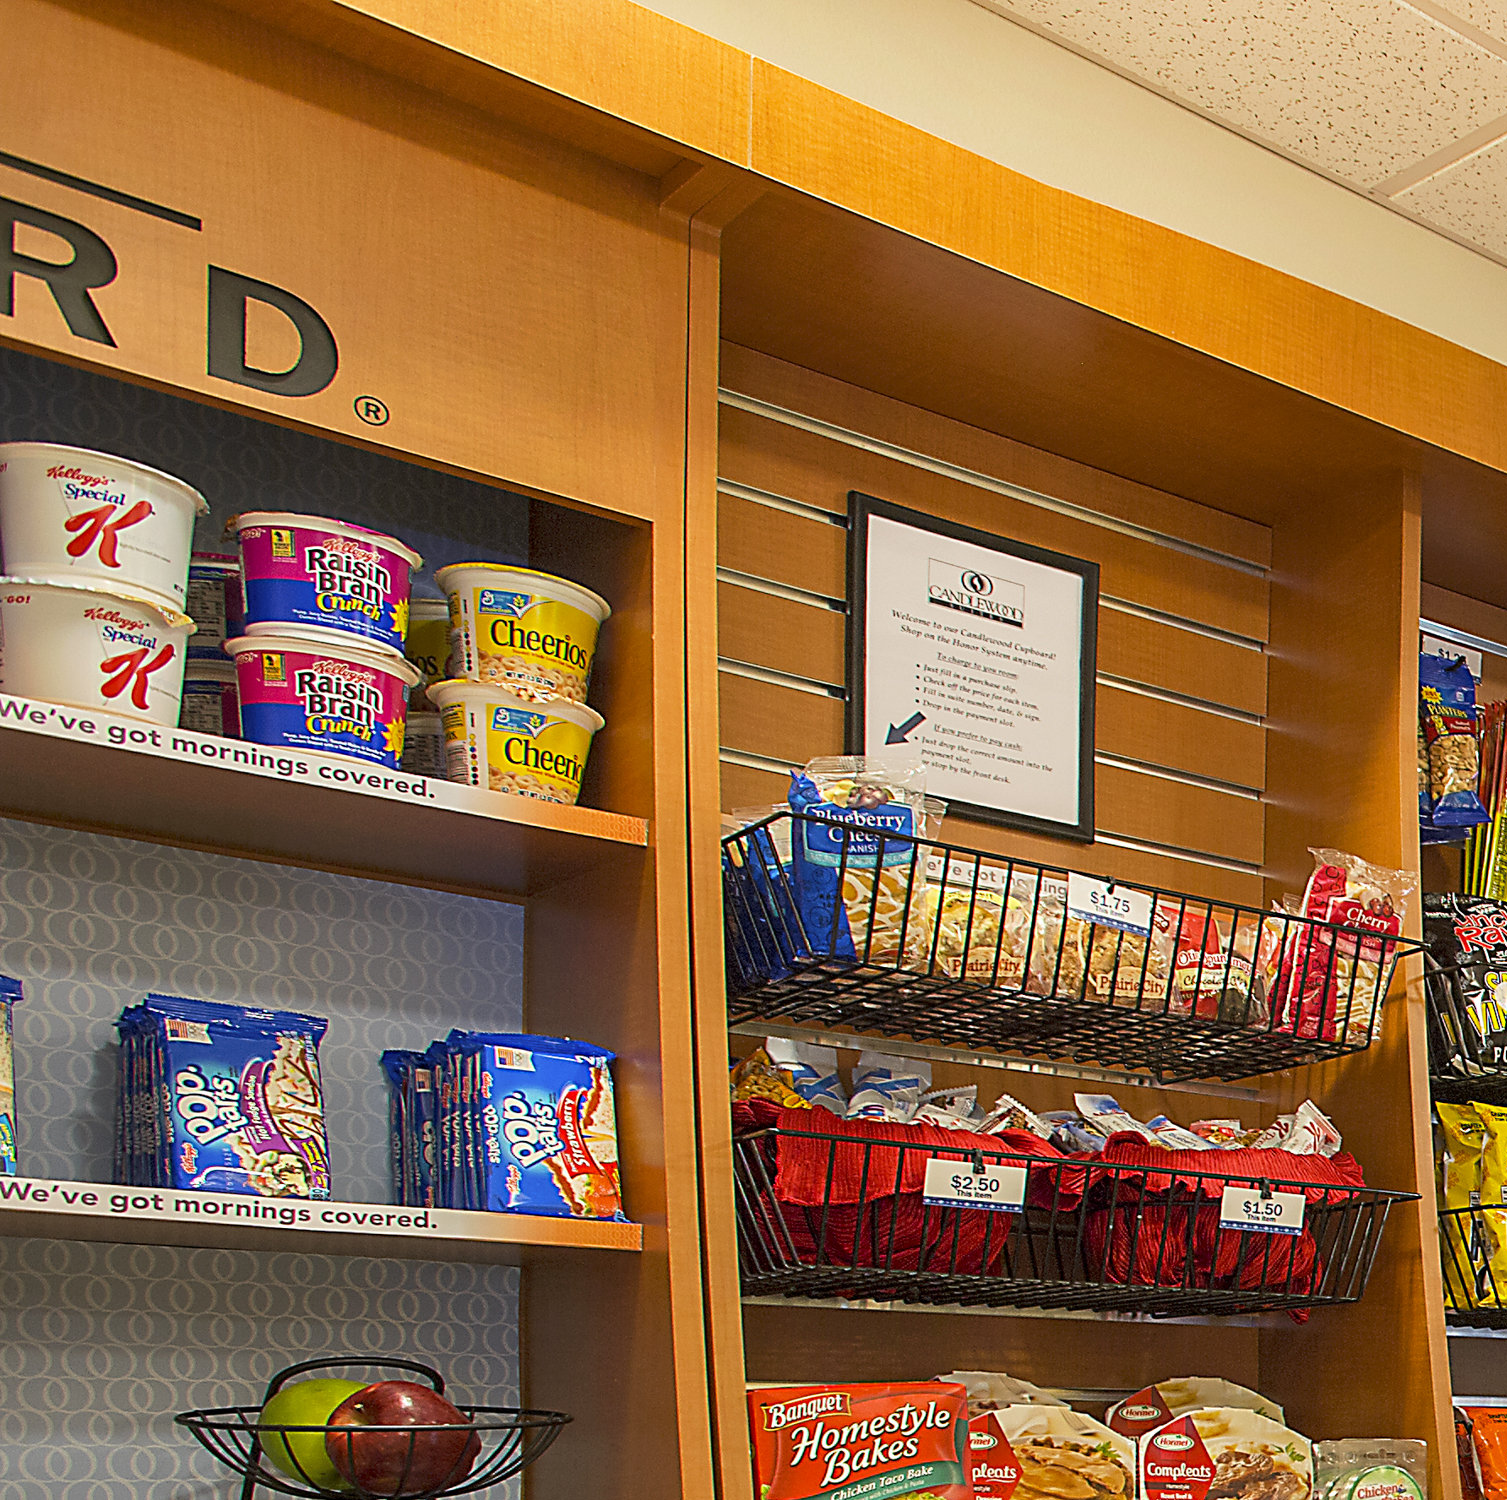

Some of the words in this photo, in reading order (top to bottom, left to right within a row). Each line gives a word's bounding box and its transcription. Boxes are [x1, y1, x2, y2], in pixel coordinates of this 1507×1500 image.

[64, 483, 126, 506] Special
[64, 501, 152, 568] K
[305, 546, 392, 594] Raisin
[315, 572, 384, 608] Bran
[316, 593, 383, 622] Crunch
[929, 585, 1024, 621] CANDLEWOOD
[103, 626, 157, 649] Special
[490, 619, 588, 669] Cheerios
[892, 609, 932, 627] Welcome
[960, 628, 1012, 649] Candlewood
[900, 625, 922, 638] Shop
[952, 638, 979, 652] Honor
[100, 644, 175, 710] K
[296, 669, 383, 715] Raisin
[305, 694, 375, 730] Bran
[307, 715, 374, 742] Crunch
[0, 699, 96, 734] We've
[108, 726, 162, 748] got
[172, 738, 308, 776] mornings
[318, 766, 436, 799] covered.
[1089, 889, 1131, 913] $1.75
[950, 1173, 1000, 1194] $2.50
[0, 1182, 98, 1206] We've
[110, 1189, 165, 1213] got
[175, 1195, 311, 1225] mornings
[321, 1210, 438, 1230] covered.
[1241, 1200, 1283, 1217] $1.50
[769, 1394, 842, 1429] Banquet
[791, 1402, 950, 1467] Homestyle
[820, 1437, 919, 1487] Bakes
[879, 1473, 905, 1488] Taco
[907, 1466, 933, 1480] Bake
[1147, 1462, 1211, 1481] Compleats
